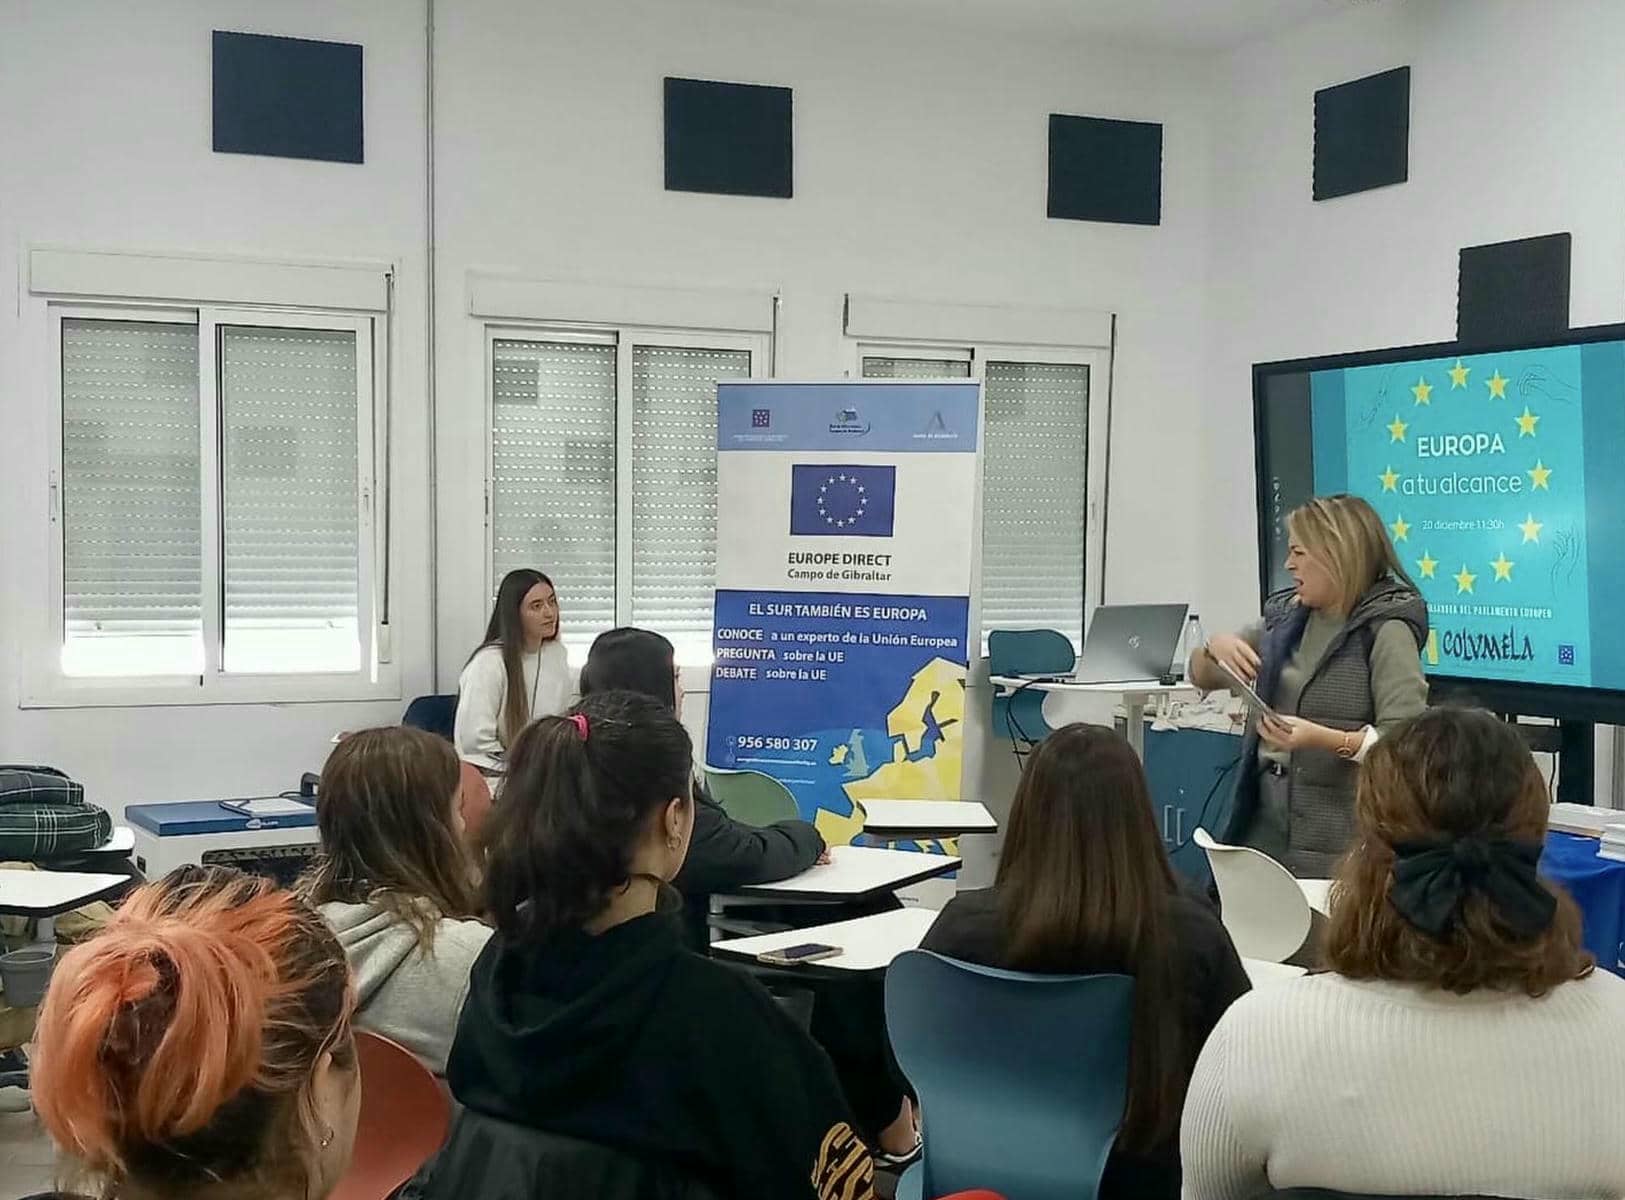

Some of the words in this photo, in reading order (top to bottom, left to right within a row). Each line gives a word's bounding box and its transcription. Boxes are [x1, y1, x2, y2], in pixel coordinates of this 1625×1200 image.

[1418, 433, 1505, 457] EUROPA
[1439, 472, 1522, 494] alcance
[788, 552, 840, 565] EUROPE
[842, 553, 893, 567] DIRECT
[787, 568, 824, 581] Campo
[826, 569, 840, 580] de
[842, 569, 892, 582] Gibraltar
[749, 604, 764, 616] EL
[767, 604, 796, 617] SUR
[797, 602, 851, 618] TAMBIÉN
[855, 606, 871, 618] ES
[873, 606, 927, 621] EUROPA
[717, 628, 764, 641] CONOCE
[771, 633, 778, 641] a
[780, 632, 795, 642] un
[797, 633, 839, 646] experto
[842, 632, 857, 644] de
[859, 633, 869, 644] la
[872, 632, 908, 646] Unión
[910, 636, 958, 650] Europea
[716, 647, 776, 661] PREGUNTA
[783, 649, 814, 662] sobre
[816, 650, 826, 662] la
[828, 651, 844, 663] UE
[715, 667, 757, 679] DEBATE
[766, 668, 796, 680] sobre
[798, 668, 809, 680] la
[810, 669, 827, 681] UE
[737, 736, 763, 748] 956
[765, 737, 790, 750] 580
[792, 738, 818, 751] 307
